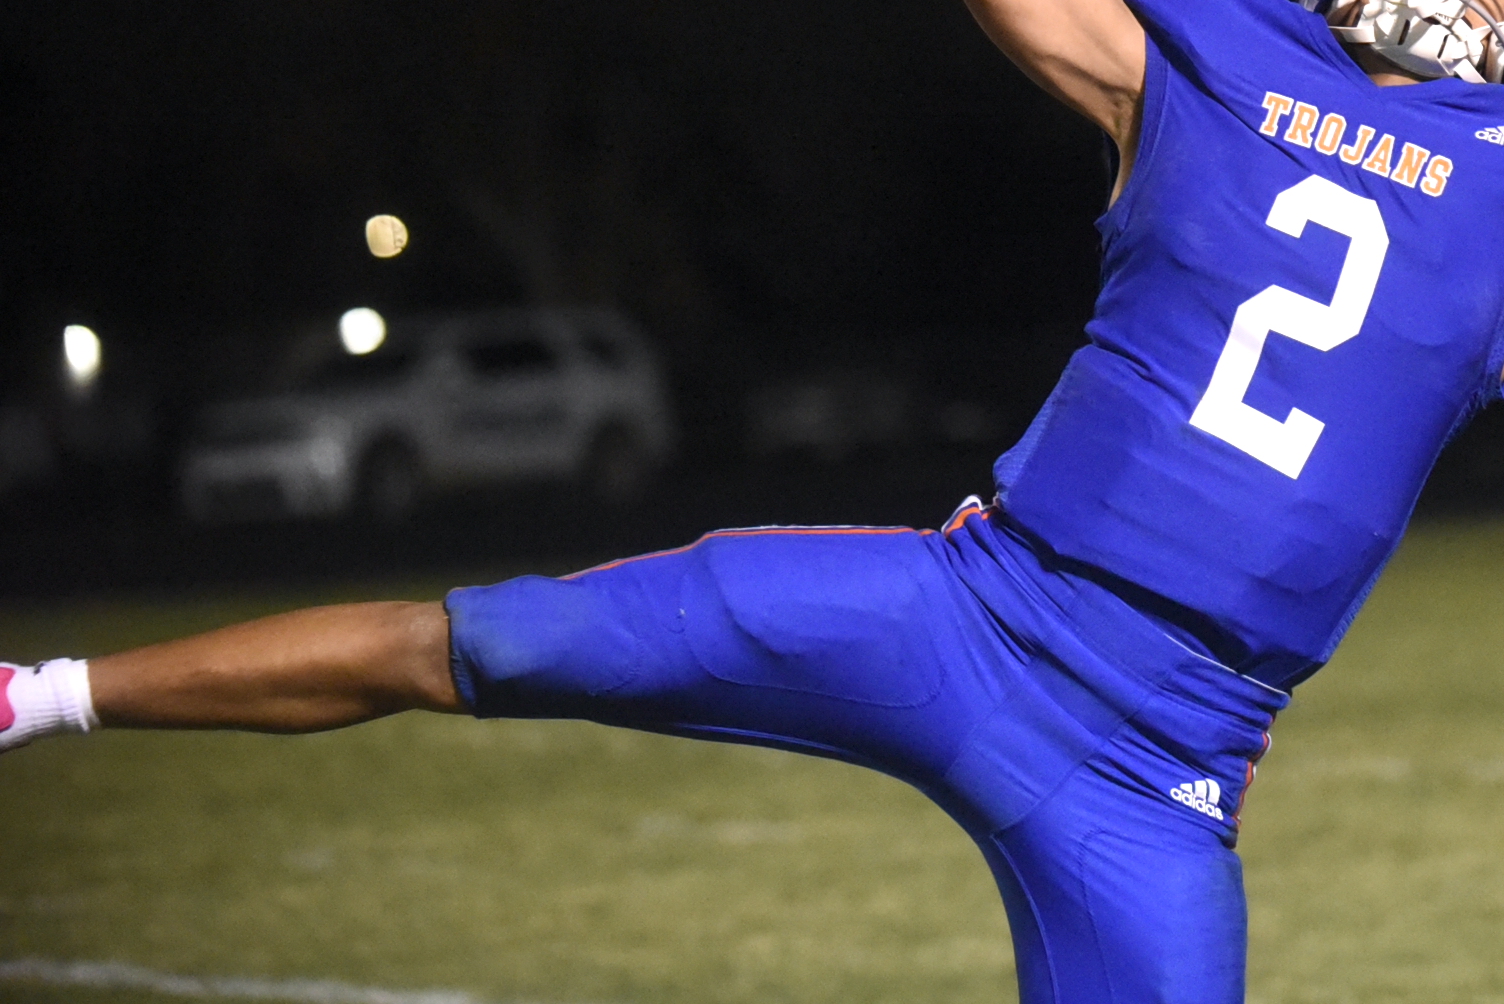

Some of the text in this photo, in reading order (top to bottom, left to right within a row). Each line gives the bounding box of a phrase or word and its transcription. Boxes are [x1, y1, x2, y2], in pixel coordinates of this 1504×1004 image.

[1260, 91, 1454, 197] TROJANS
[1188, 173, 1390, 480] 2
[1170, 787, 1224, 821] adidas
